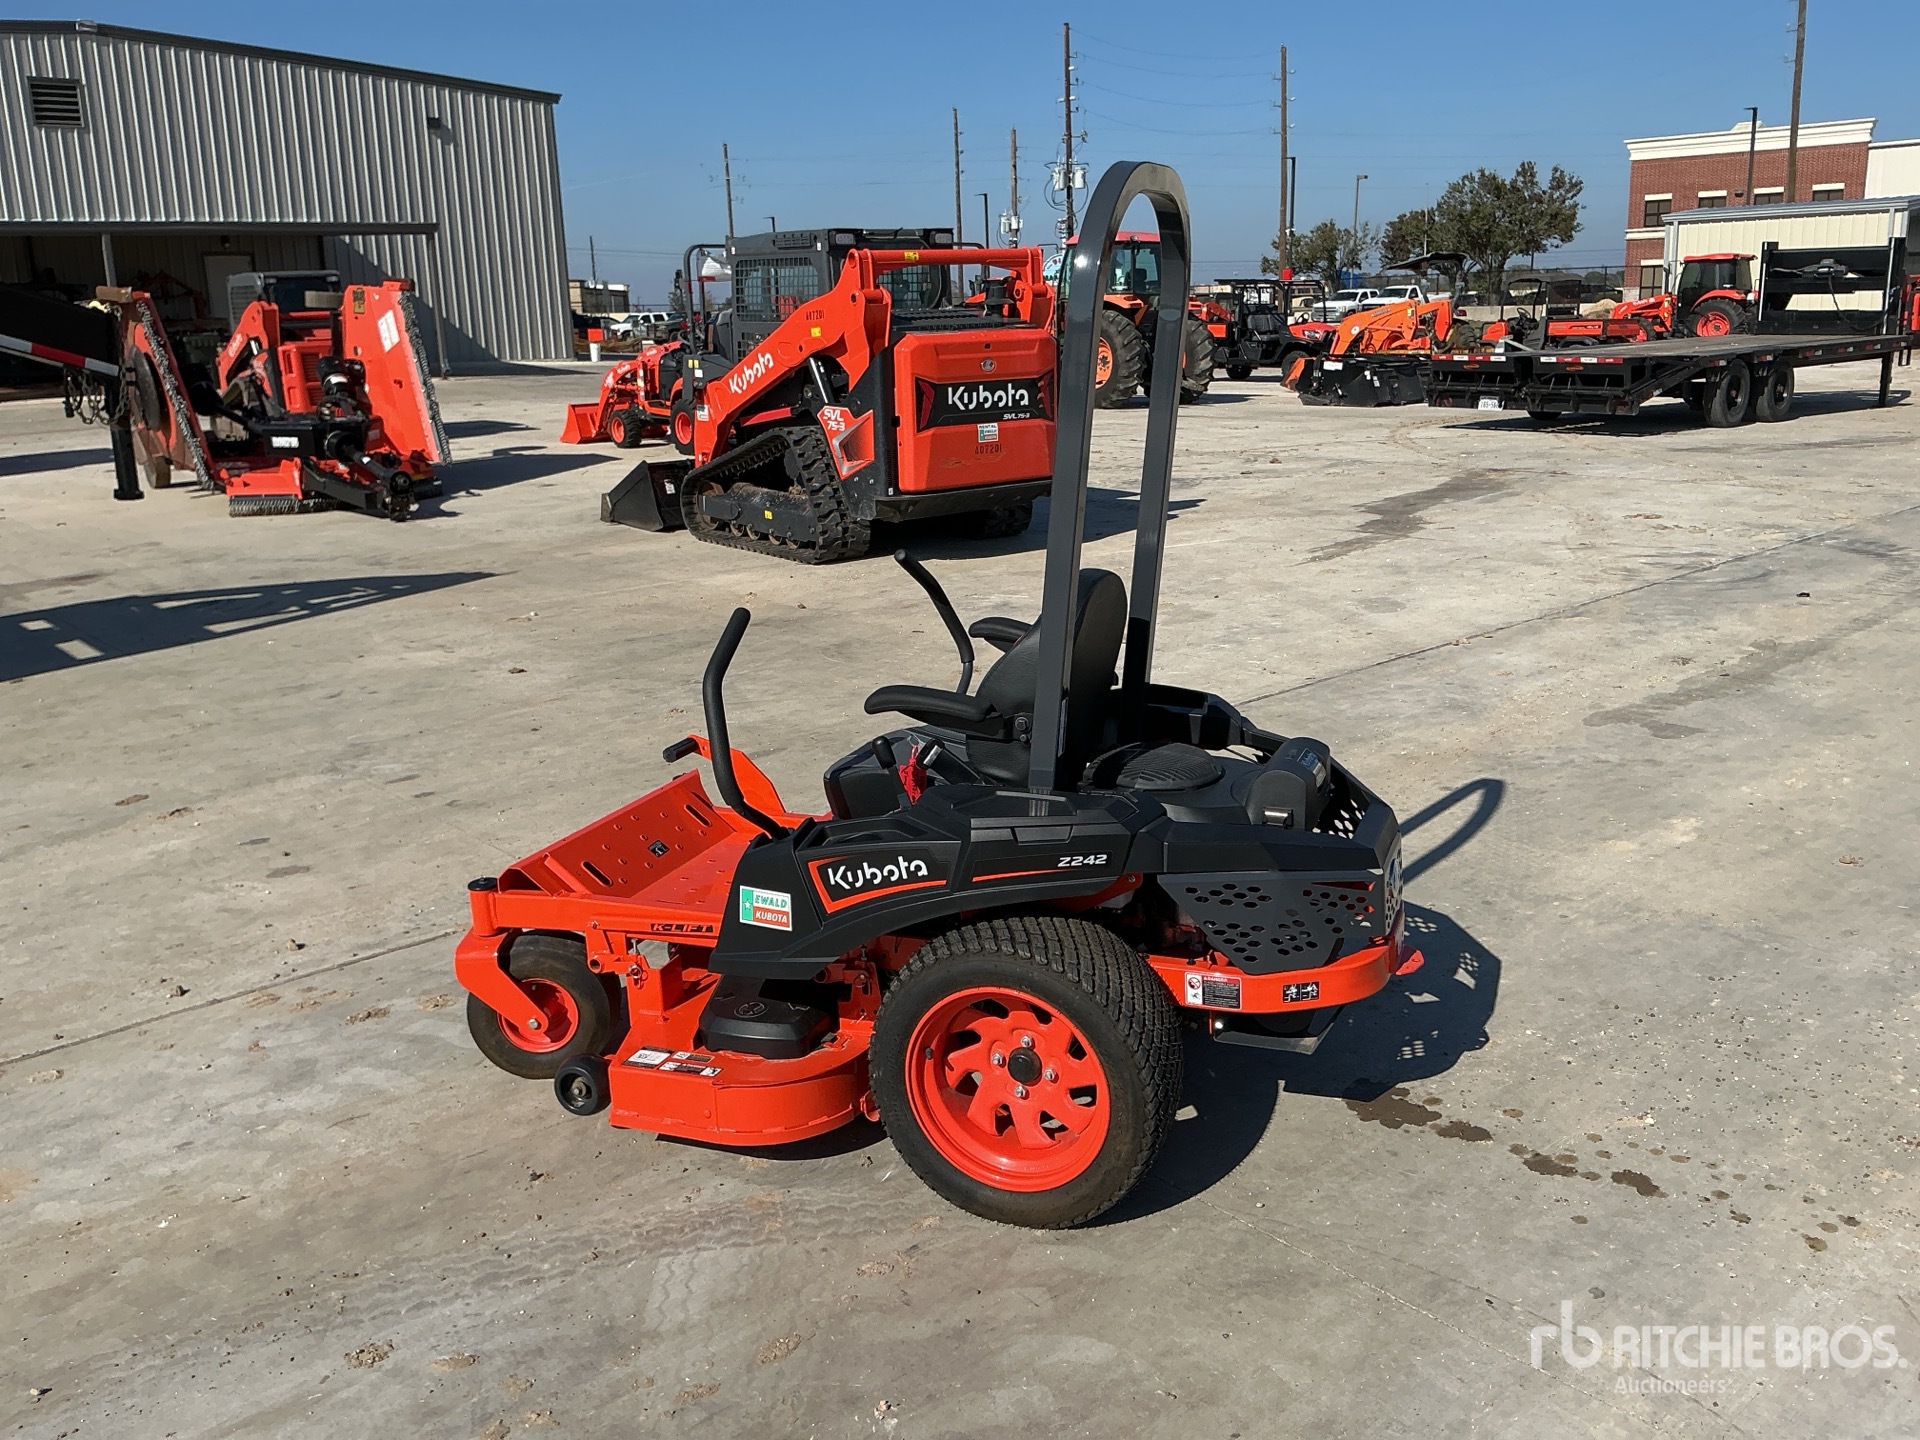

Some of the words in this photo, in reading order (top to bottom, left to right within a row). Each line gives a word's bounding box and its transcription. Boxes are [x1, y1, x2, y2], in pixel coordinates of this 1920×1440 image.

[728, 352, 775, 395] Kubota
[947, 383, 1029, 410] Kubota
[823, 408, 845, 422] SVL
[1057, 854, 1107, 868] Z242
[827, 855, 928, 890] Kubota
[754, 894, 788, 909] EWALD
[755, 910, 788, 924] KUBOTA
[652, 923, 709, 933] K-LIFT
